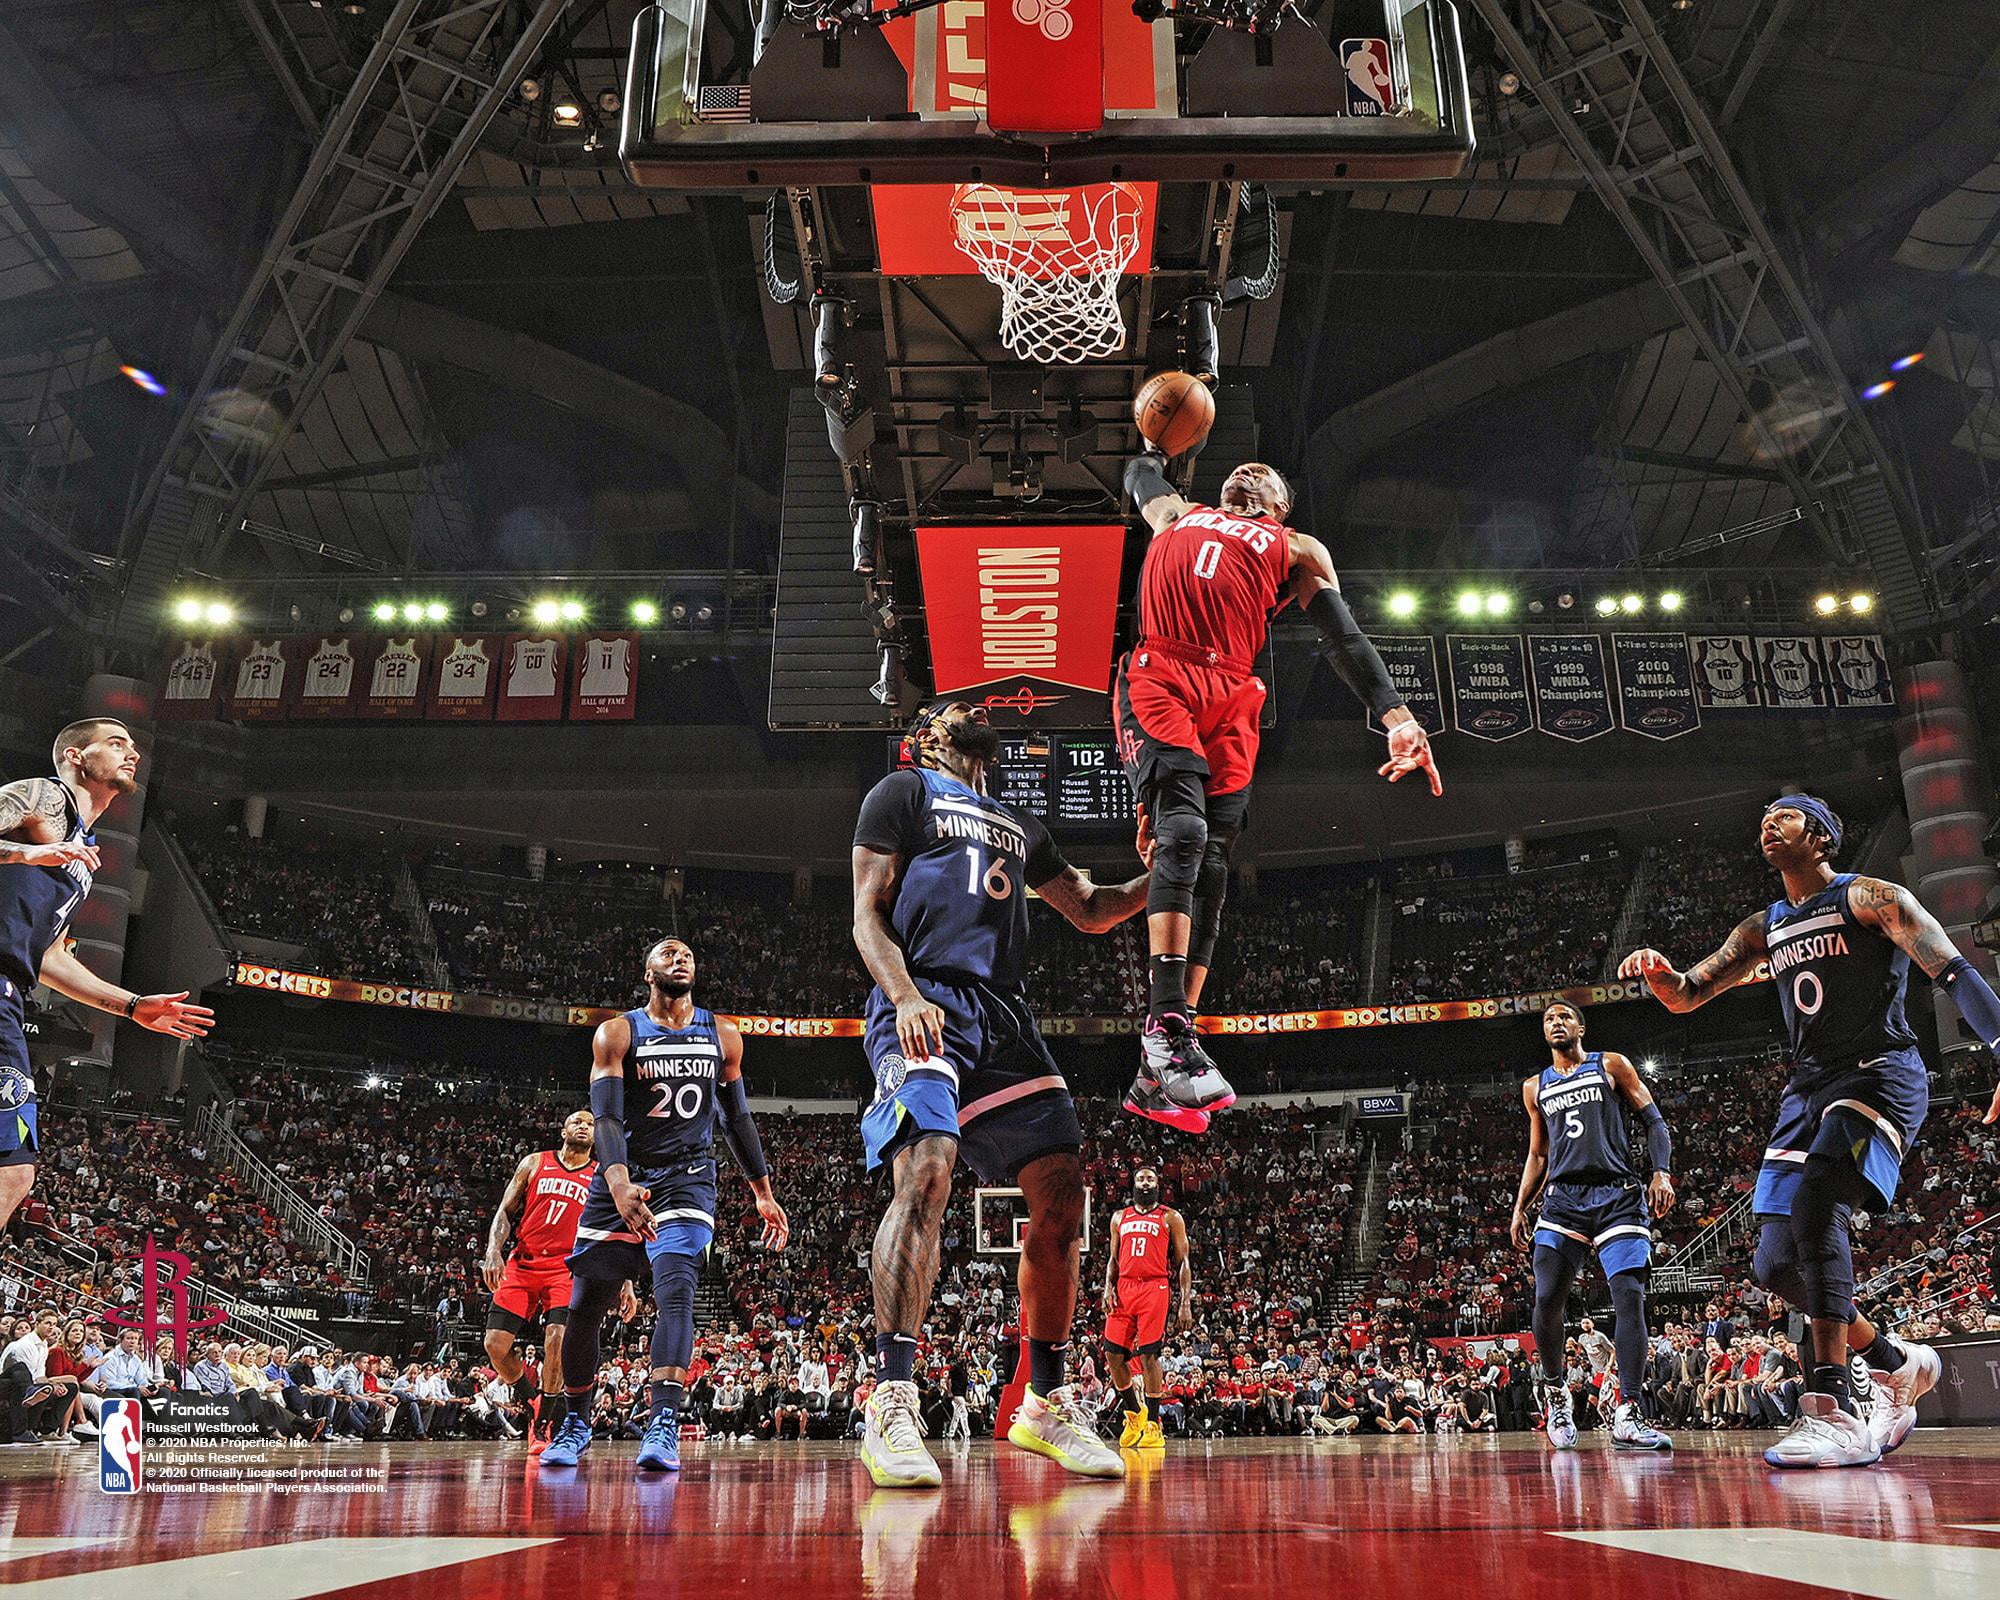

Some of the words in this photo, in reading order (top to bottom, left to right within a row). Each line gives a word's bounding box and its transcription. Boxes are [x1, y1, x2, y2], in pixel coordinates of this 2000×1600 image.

[1353, 102, 1377, 115] NBA
[1174, 513, 1277, 555] ROCKETS
[1194, 540, 1224, 580] 0
[977, 547, 1061, 669] HOUSTON
[1551, 644, 1558, 652] 3
[313, 654, 351, 664] MALONE
[445, 654, 487, 665] OLAJUWON
[602, 655, 612, 670] 11
[1638, 661, 1670, 671] 2000
[182, 665, 202, 680] 45
[252, 664, 271, 680] 23
[319, 663, 341, 678] 24
[386, 663, 407, 678] 22
[453, 663, 476, 678] 34
[1388, 664, 1416, 675] 1997
[1472, 663, 1505, 674] 1998
[1554, 663, 1585, 674] 1999
[1717, 669, 1733, 680] 10
[1393, 678, 1422, 688] NBA
[1469, 676, 1511, 687] WNBA
[1550, 676, 1591, 687] WNBA
[1636, 674, 1676, 684] WNBA
[1399, 691, 1436, 702] pions
[1458, 688, 1525, 702] Champions
[1540, 688, 1604, 702] Champions
[1625, 687, 1691, 699] Champions
[581, 698, 597, 706] HALL
[607, 697, 626, 705] FAME
[1004, 746, 1029, 759] 1:5
[1069, 750, 1105, 766] 102
[935, 815, 1027, 863] MINNESOTA
[966, 846, 1012, 900] 16
[1771, 932, 1850, 975] MINNESOTA
[361, 985, 464, 1012] ROCKETS
[1591, 982, 1653, 1003] ROCK
[1794, 971, 1824, 1015] 0
[491, 999, 589, 1025] ROCKETS
[1467, 991, 1567, 1018] ROCKETS
[1222, 1012, 1318, 1033] ROCKETS
[1343, 1004, 1442, 1027] ROCKETS
[738, 1017, 834, 1036] ROCKETS
[636, 1058, 716, 1081] MINNESOTA
[647, 1082, 703, 1119] 20
[1363, 1097, 1396, 1109] BBVA
[1541, 1086, 1604, 1117] MINNESOTA
[1565, 1109, 1585, 1139] 5
[536, 1177, 590, 1206] ROCKETS
[545, 1200, 569, 1225] 17
[1131, 1237, 1147, 1257] 13
[272, 1305, 320, 1321] TUNNEL
